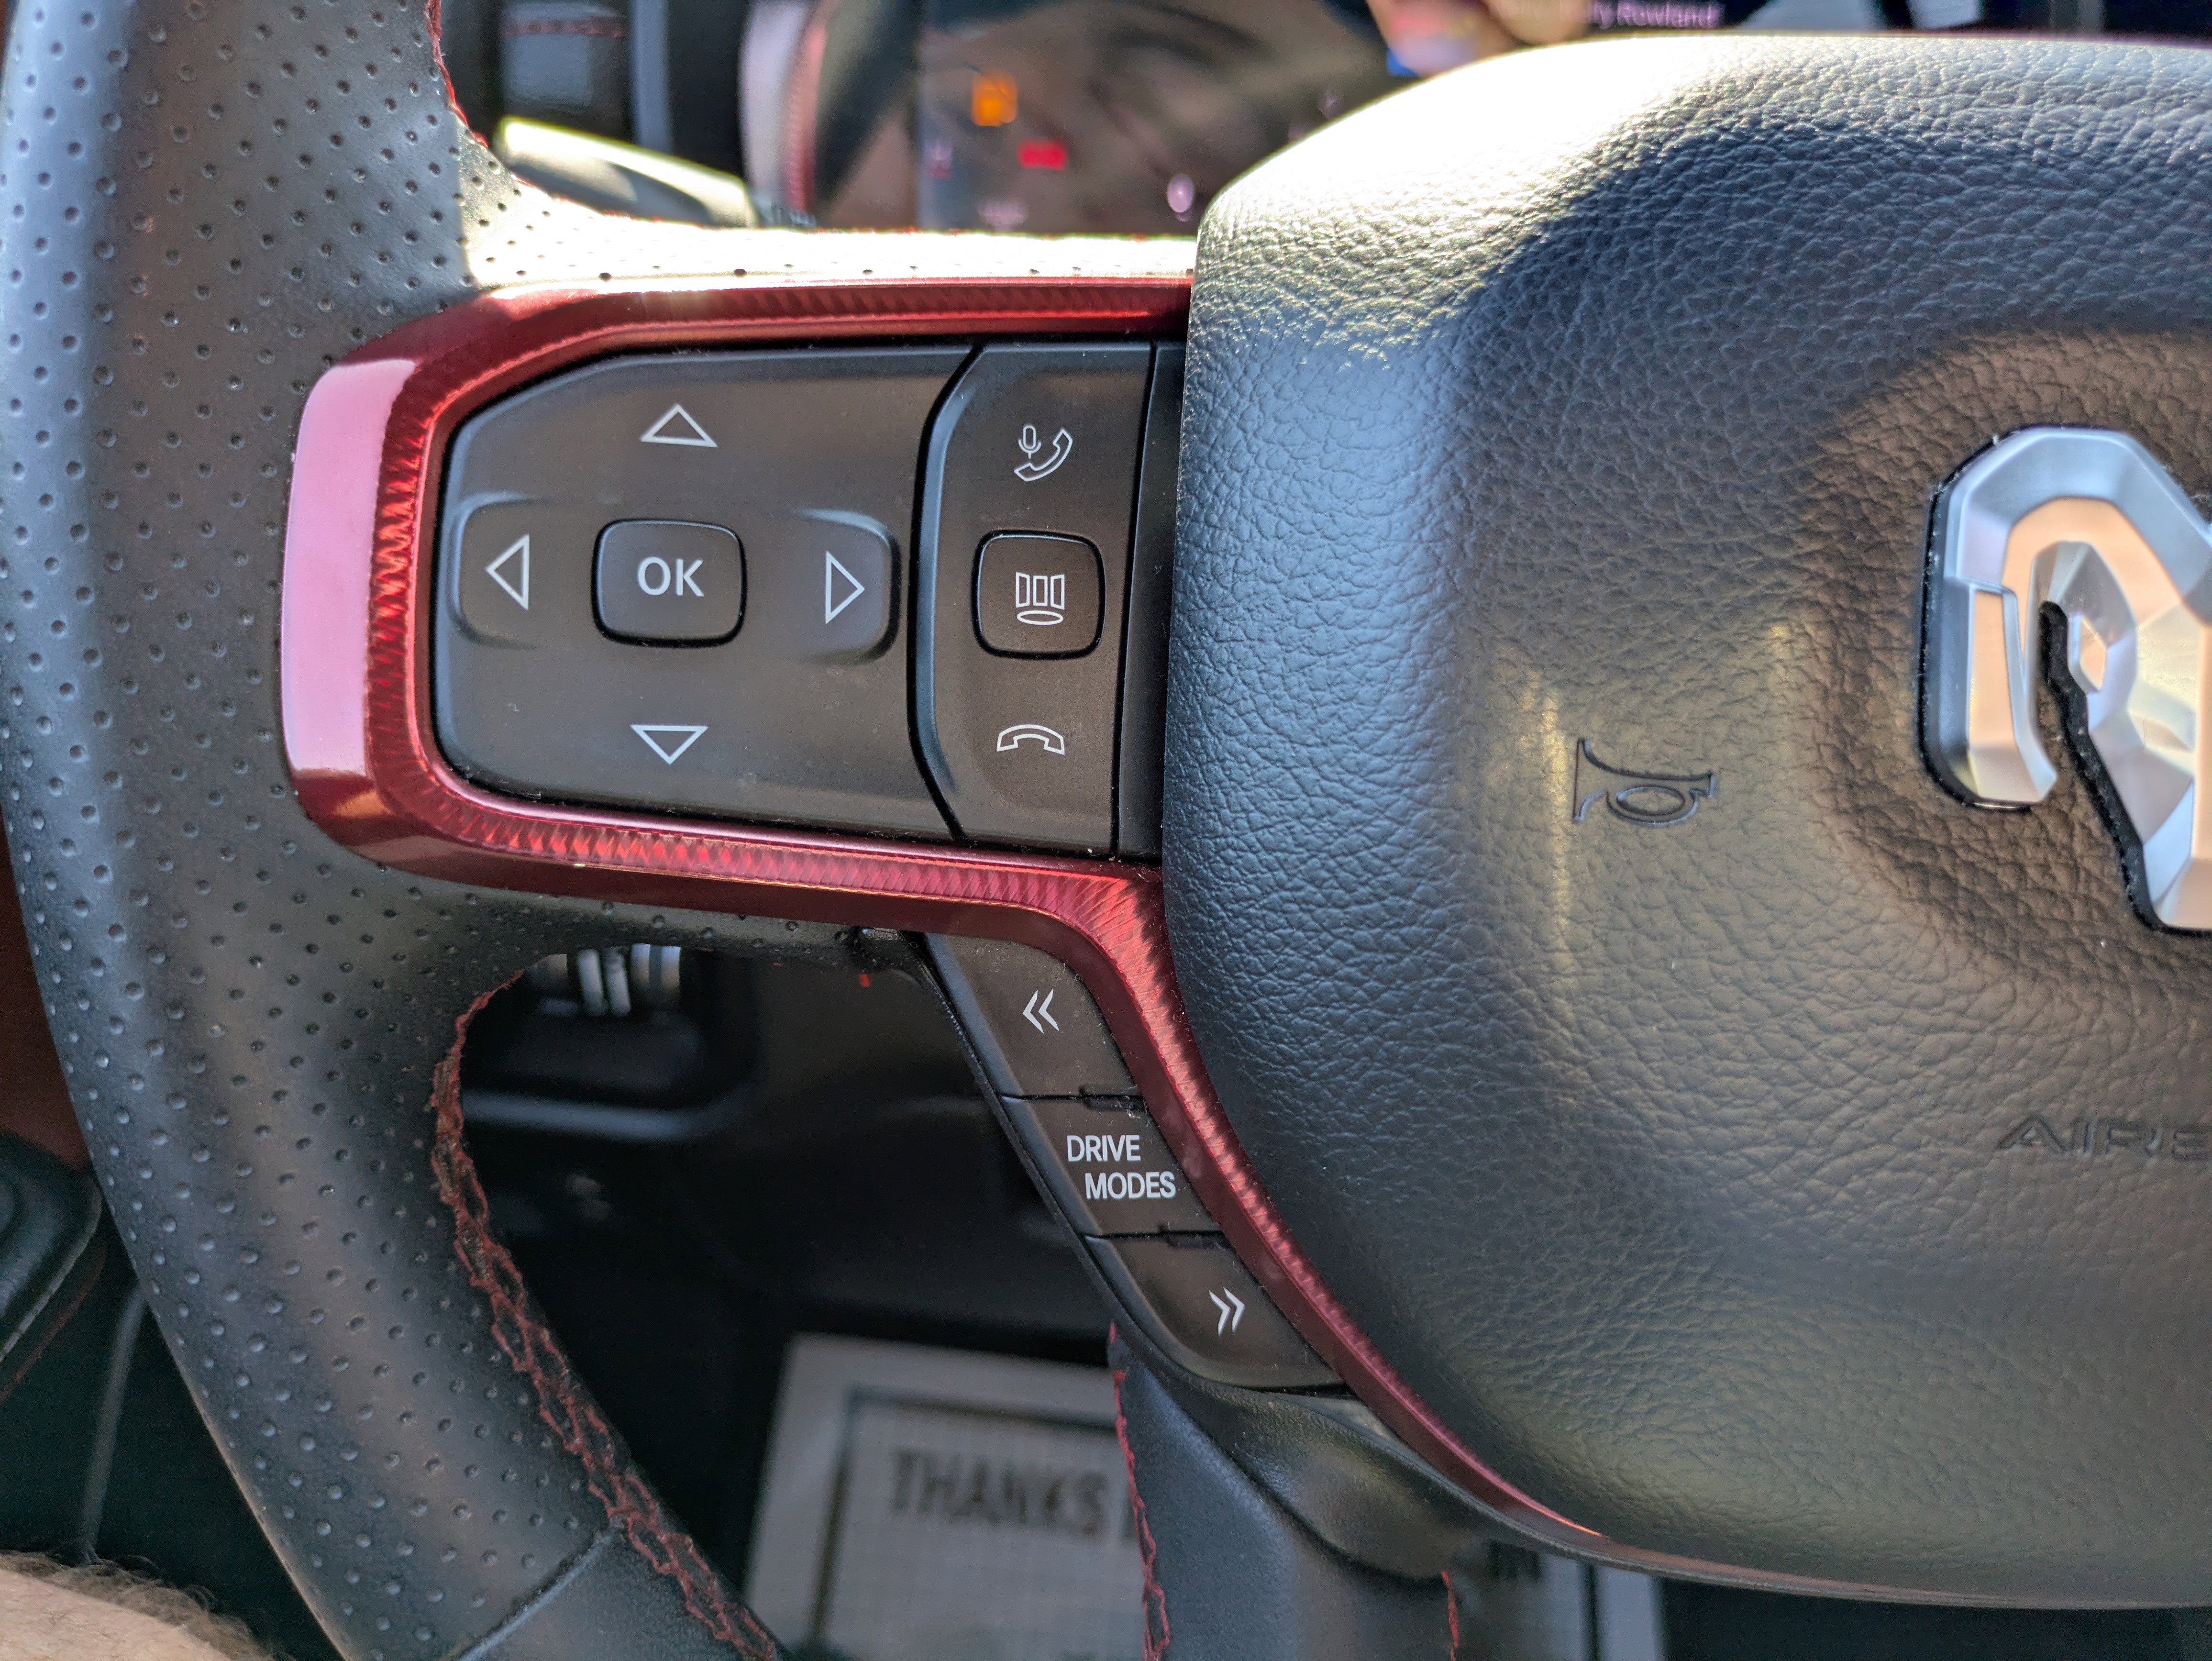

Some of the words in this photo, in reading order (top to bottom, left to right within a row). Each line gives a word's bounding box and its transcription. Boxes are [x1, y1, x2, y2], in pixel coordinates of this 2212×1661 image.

[638, 556, 704, 597] OK
[1067, 1135, 1141, 1162] DRIVE
[1085, 1171, 1176, 1199] MODES
[891, 1447, 1109, 1538] THANKS
